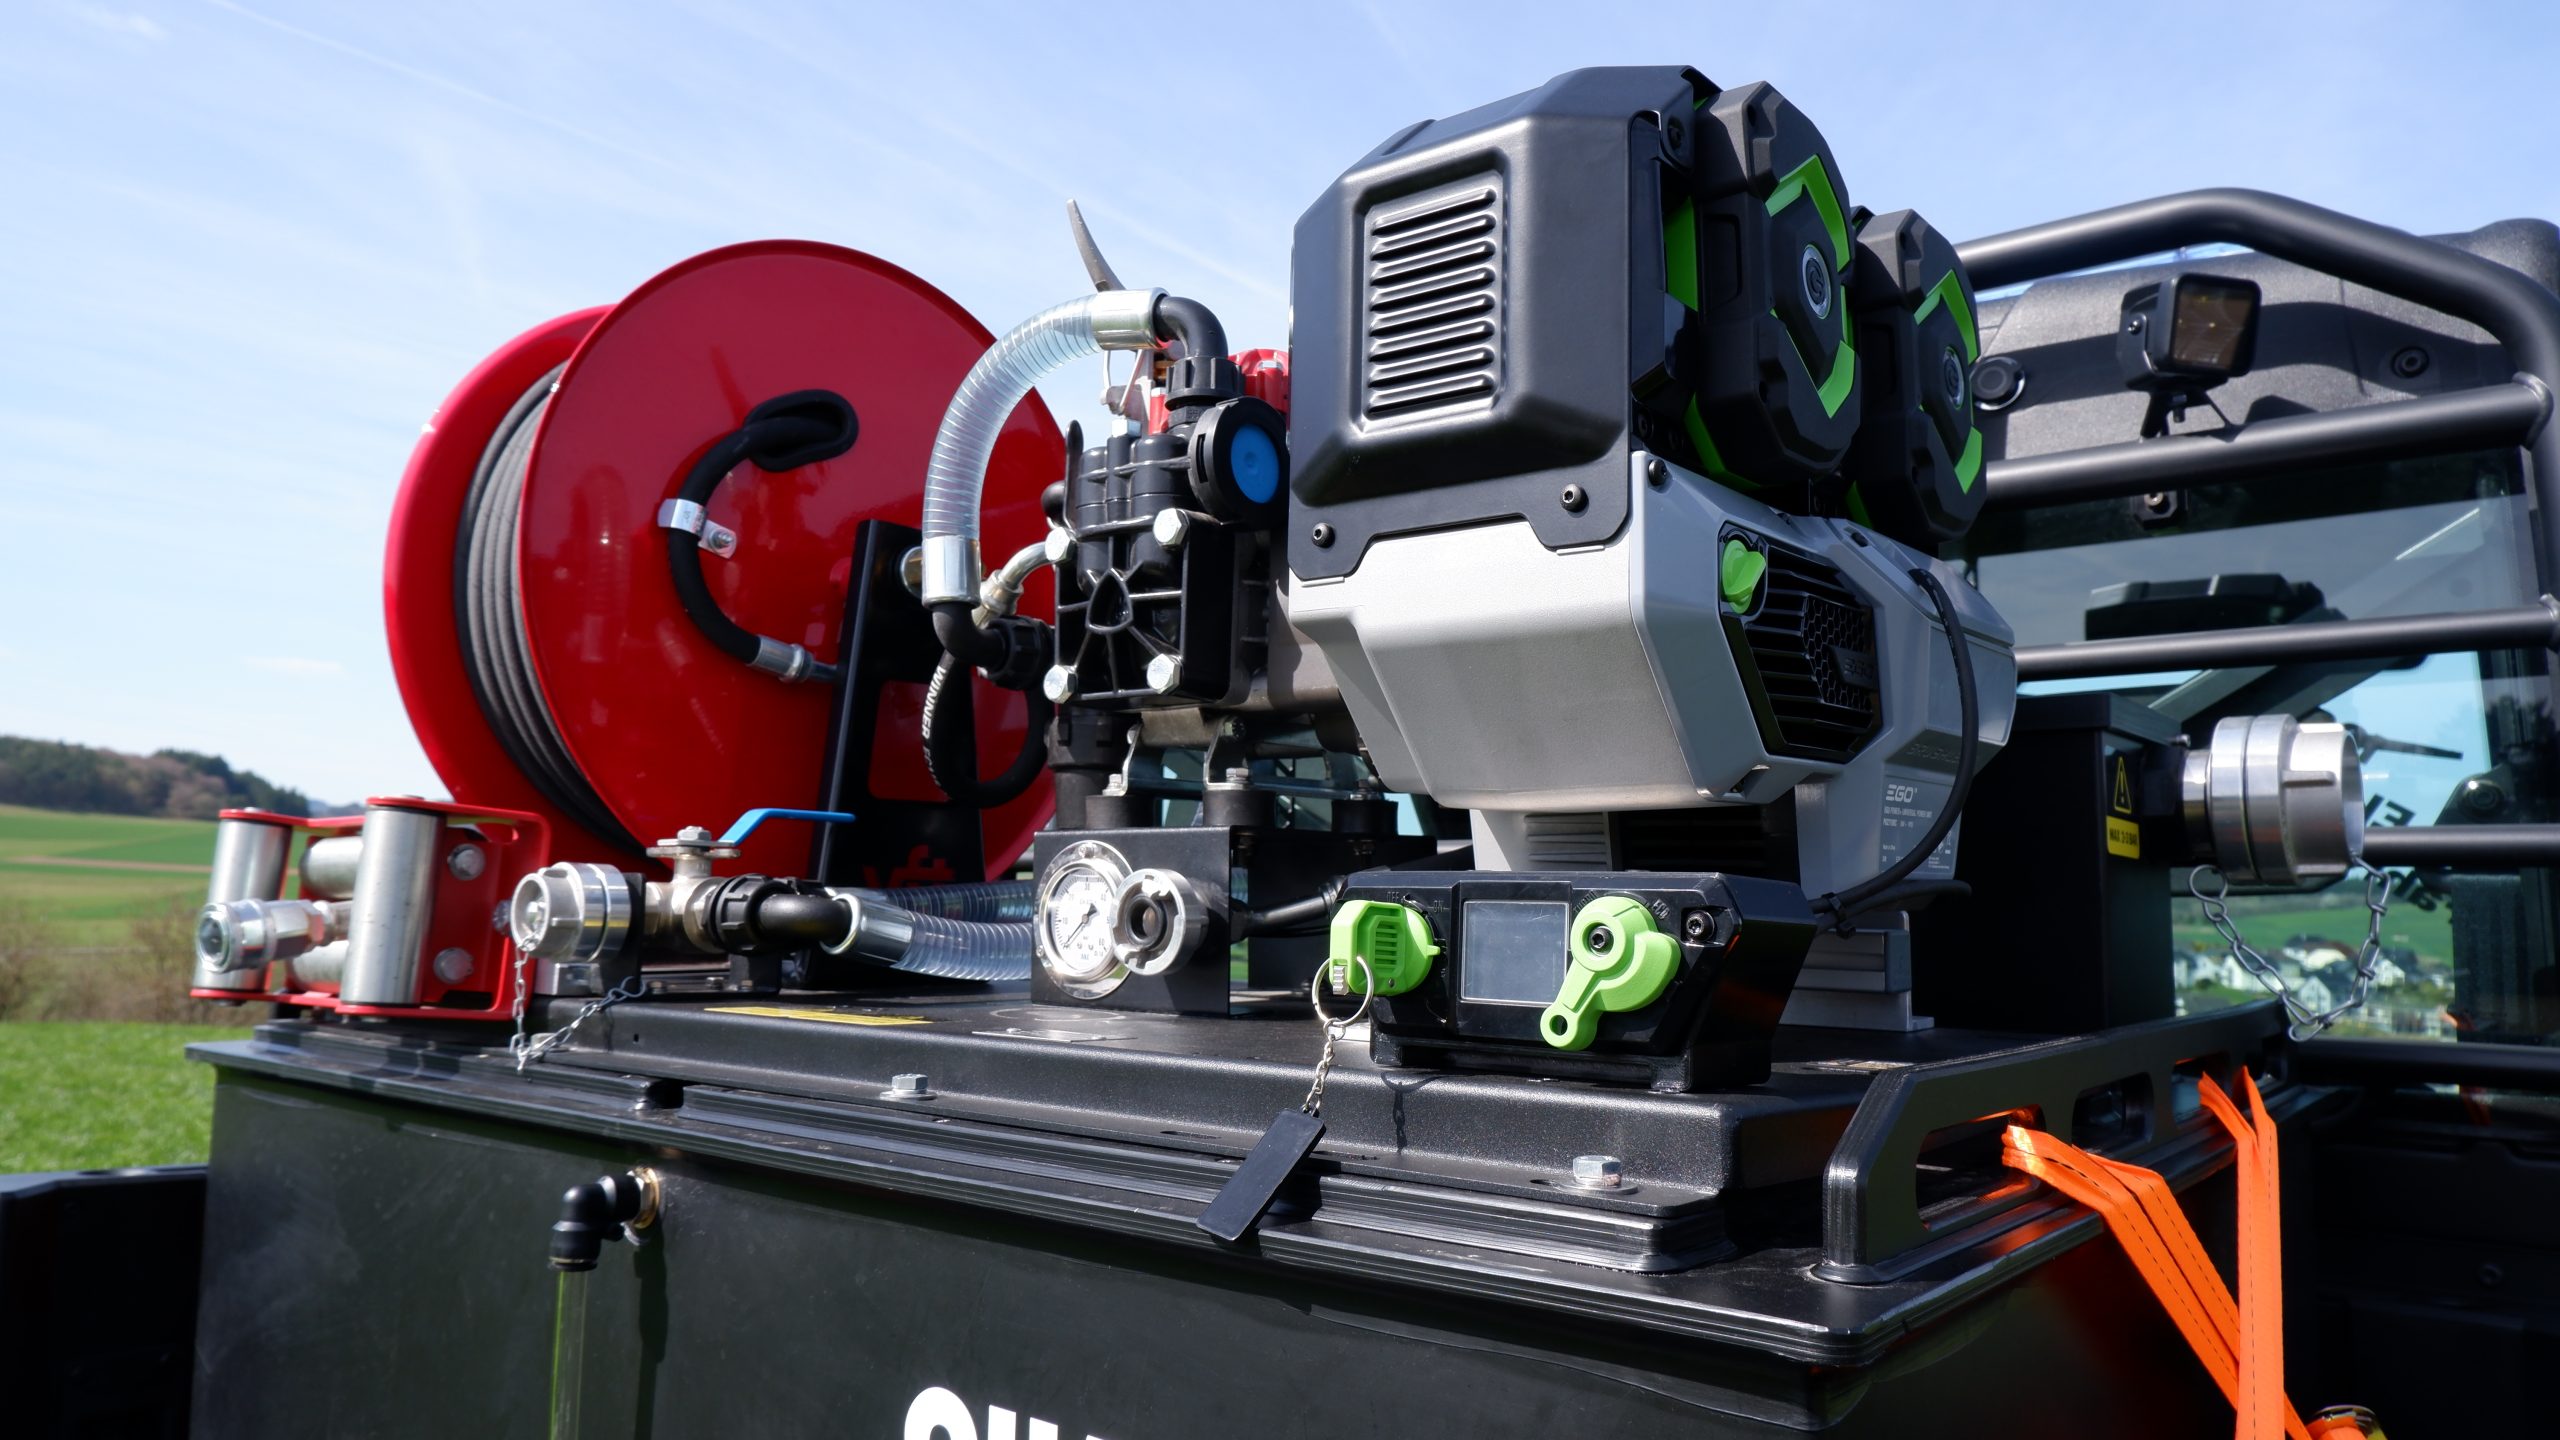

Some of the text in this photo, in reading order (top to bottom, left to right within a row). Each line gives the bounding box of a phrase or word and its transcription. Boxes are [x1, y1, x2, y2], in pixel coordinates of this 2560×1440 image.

[921, 665, 947, 740] WINNER
[1885, 784, 1914, 803] EGO
[1652, 899, 1670, 919] ECO
